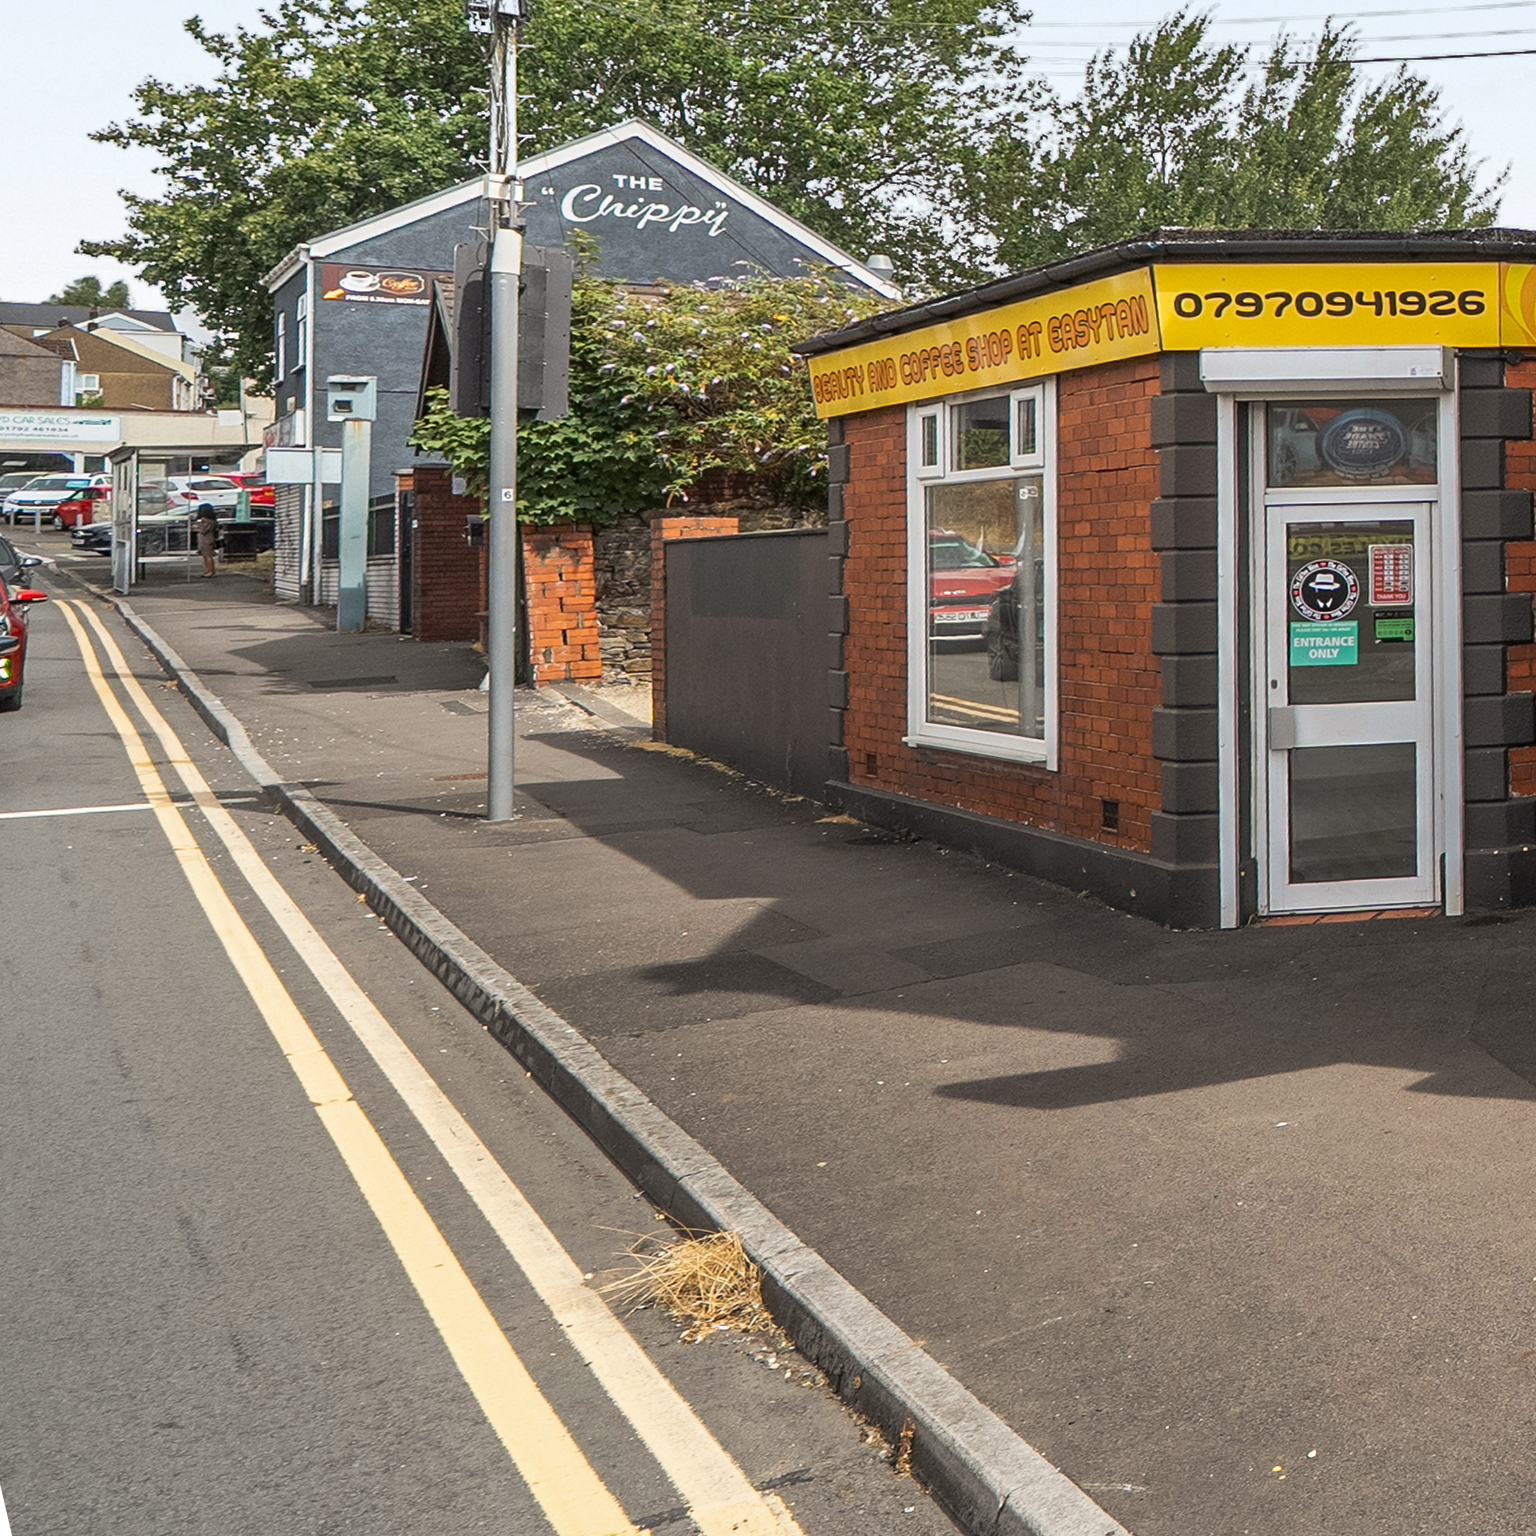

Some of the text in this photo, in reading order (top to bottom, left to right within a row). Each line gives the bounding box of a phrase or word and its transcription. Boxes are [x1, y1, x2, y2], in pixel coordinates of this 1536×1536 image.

[612, 174, 663, 191] THE
[1173, 288, 1487, 319] 07970941926
[813, 294, 1149, 404] BEAUTY AND COFFEE SHOP AT EASYTAN
[13, 416, 35, 424] CAR
[37, 417, 71, 425] SALES
[503, 490, 512, 500] 6
[1293, 636, 1355, 648] ENTRANCE
[1308, 648, 1340, 659] ONLY
